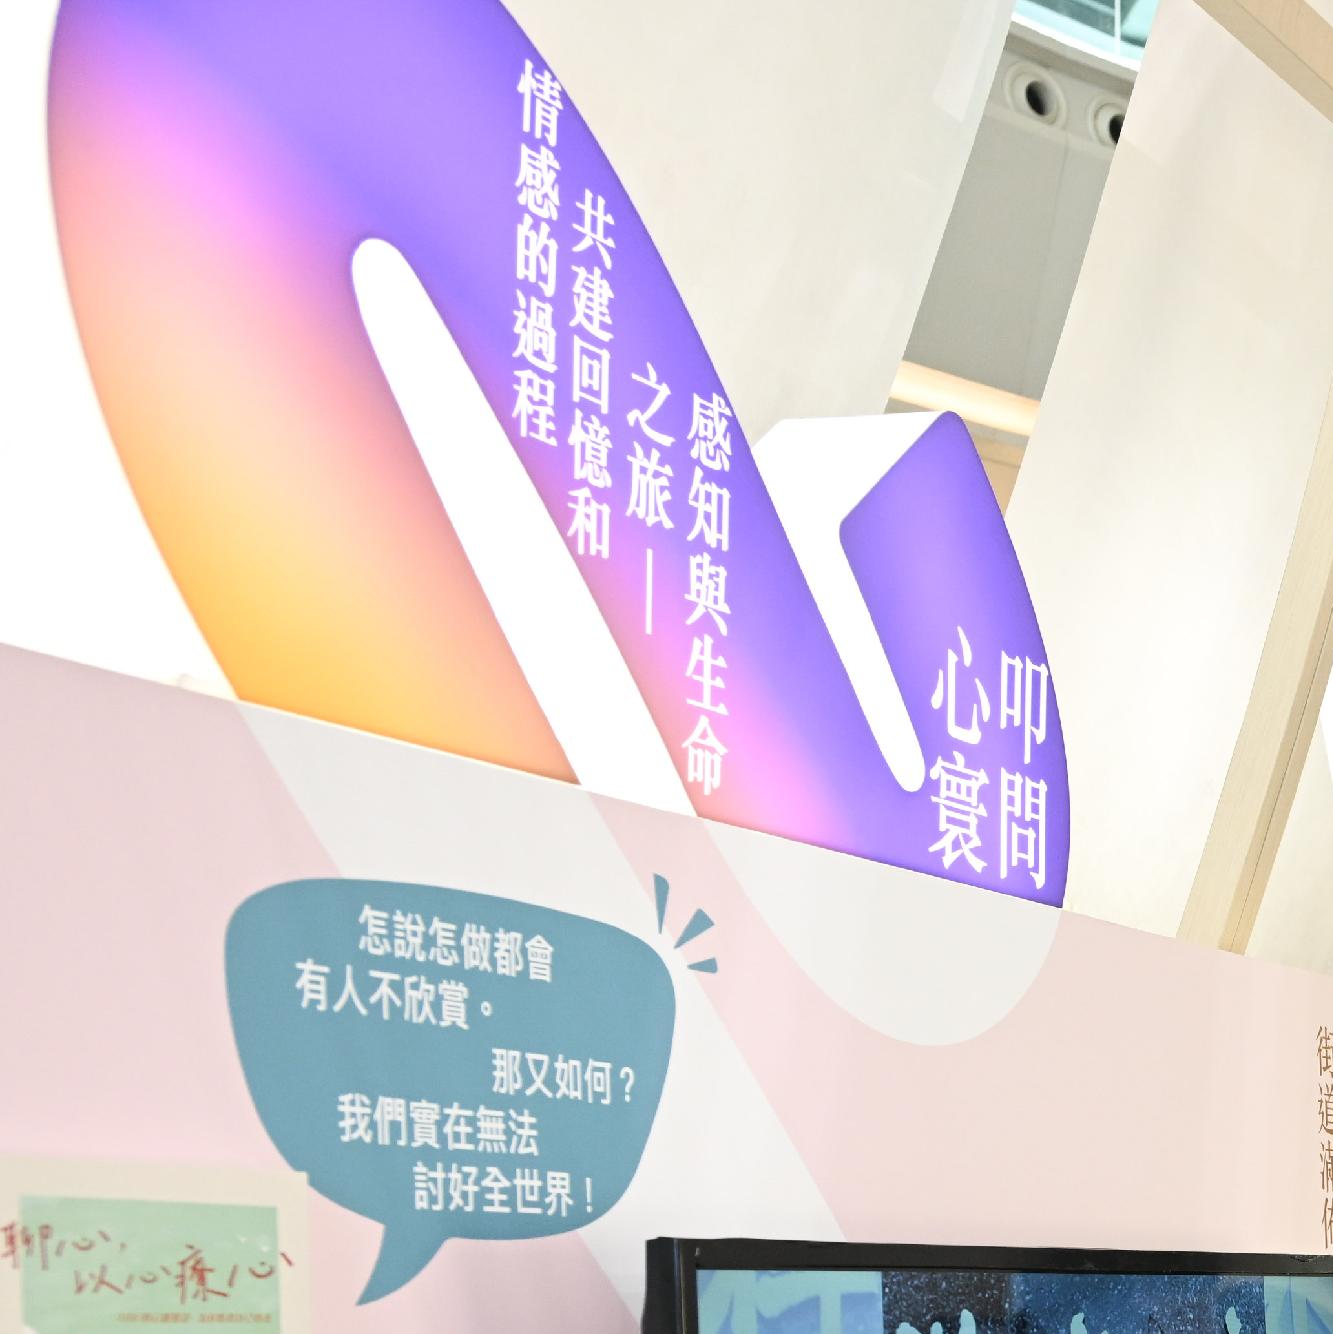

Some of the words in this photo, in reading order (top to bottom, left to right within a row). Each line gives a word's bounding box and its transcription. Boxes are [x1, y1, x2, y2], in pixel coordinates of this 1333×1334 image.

[511, 59, 563, 448] 情感的過程
[568, 189, 616, 560] 共建回憶和
[682, 393, 733, 796] 感知與生命
[929, 626, 992, 873] 心寰
[1000, 651, 1048, 889] 叩問
[295, 959, 494, 1031] 有人不欣賞。
[358, 905, 554, 982] 怎說怎做都會
[337, 1093, 540, 1157] 我們實在無法
[491, 1048, 637, 1106] 那又如何？
[413, 1161, 594, 1218] 討好全世界！
